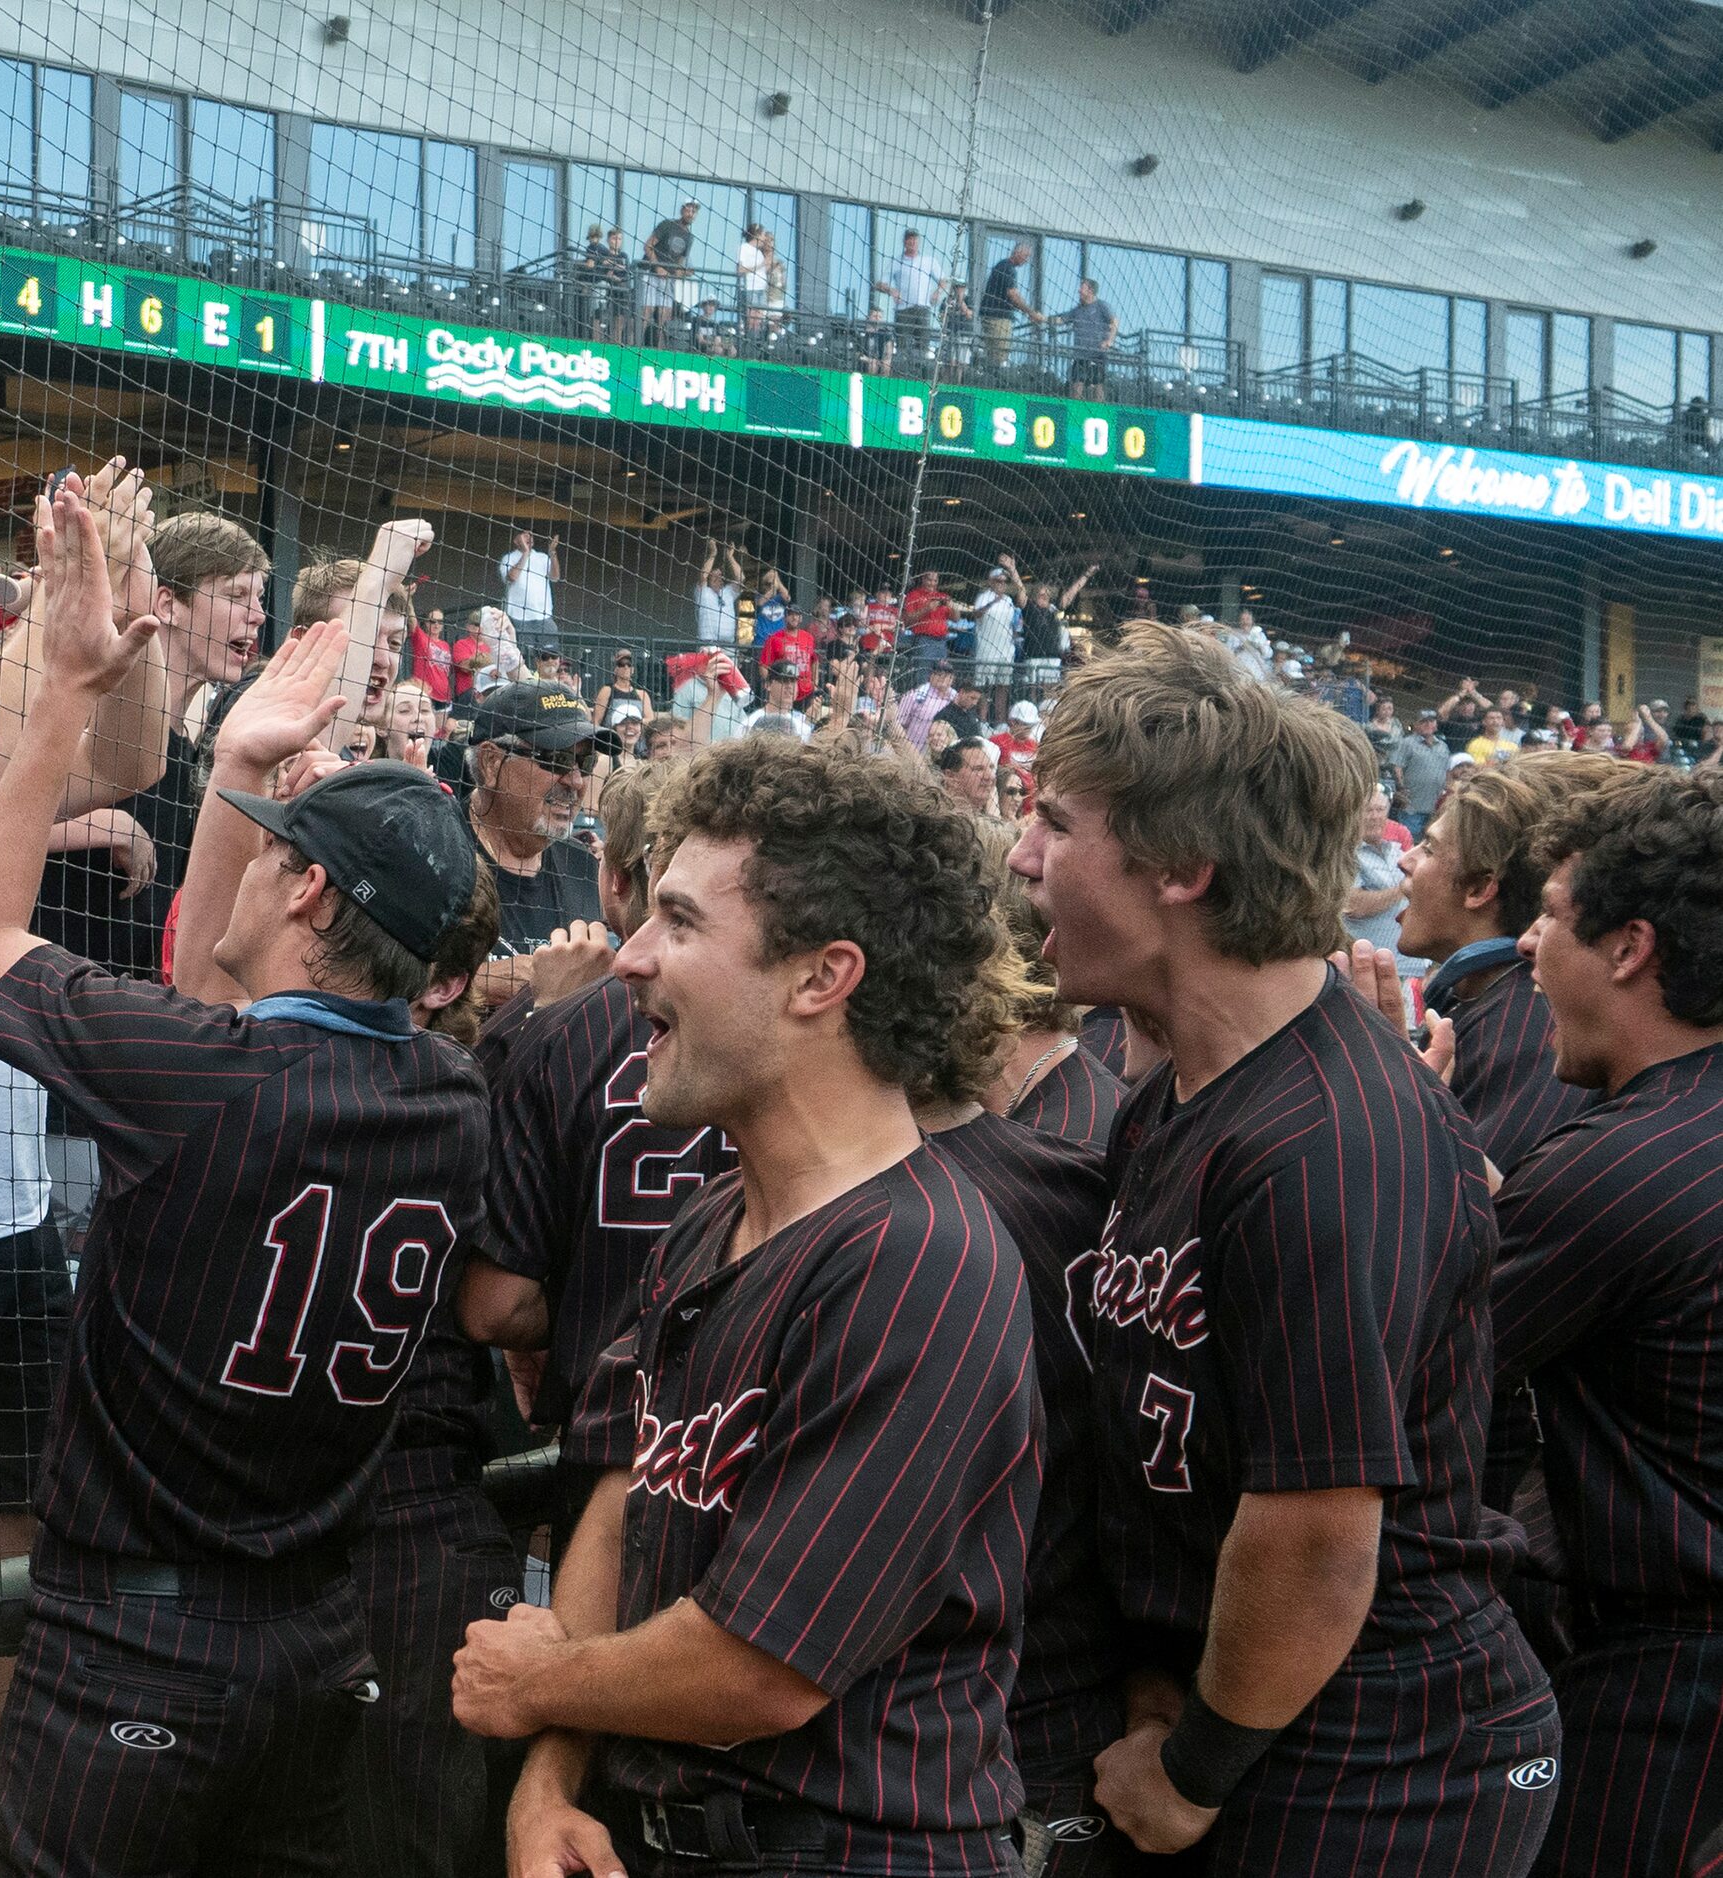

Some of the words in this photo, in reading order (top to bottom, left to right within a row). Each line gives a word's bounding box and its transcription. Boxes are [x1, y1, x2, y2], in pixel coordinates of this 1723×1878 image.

[17, 276, 42, 316] 4
[81, 281, 113, 328] H
[140, 297, 163, 334] 6
[203, 300, 230, 348] E
[255, 315, 275, 353] 1
[346, 330, 409, 374] 7TH
[425, 328, 515, 371] Cody
[520, 341, 611, 382] Pools
[640, 365, 726, 414] MPH
[898, 395, 924, 436] B
[939, 404, 963, 440] 0
[992, 406, 1018, 447] S
[1032, 415, 1056, 449] 0
[1123, 426, 1146, 459] 0
[1379, 441, 1551, 508] Welcome
[1550, 460, 1591, 517] to
[1603, 473, 1672, 527] Dell
[220, 1183, 457, 1406] 19
[1140, 1372, 1196, 1493] 7
